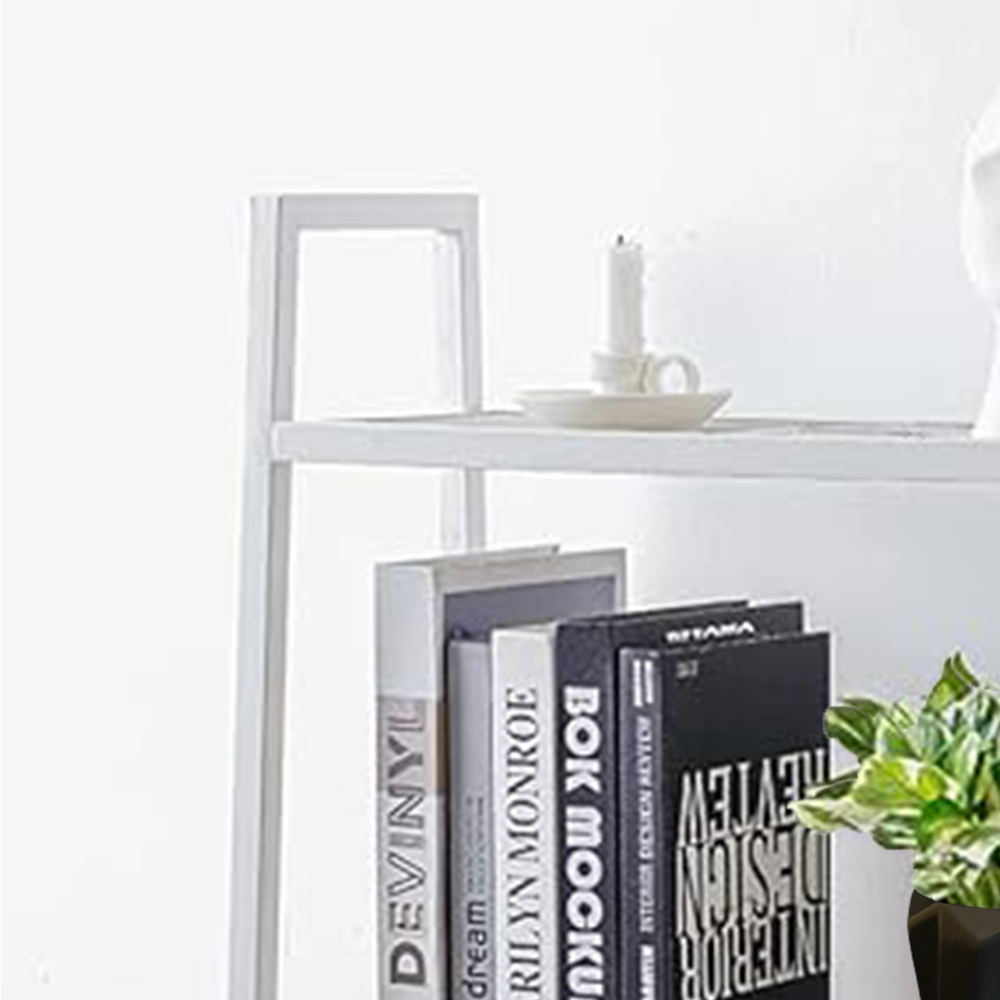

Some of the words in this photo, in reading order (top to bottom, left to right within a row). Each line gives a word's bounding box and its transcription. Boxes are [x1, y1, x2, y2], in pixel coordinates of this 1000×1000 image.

[505, 687, 541, 861] MONROE
[563, 685, 602, 794] BOK
[676, 822, 828, 938] DESIGN
[460, 901, 488, 999] dream
